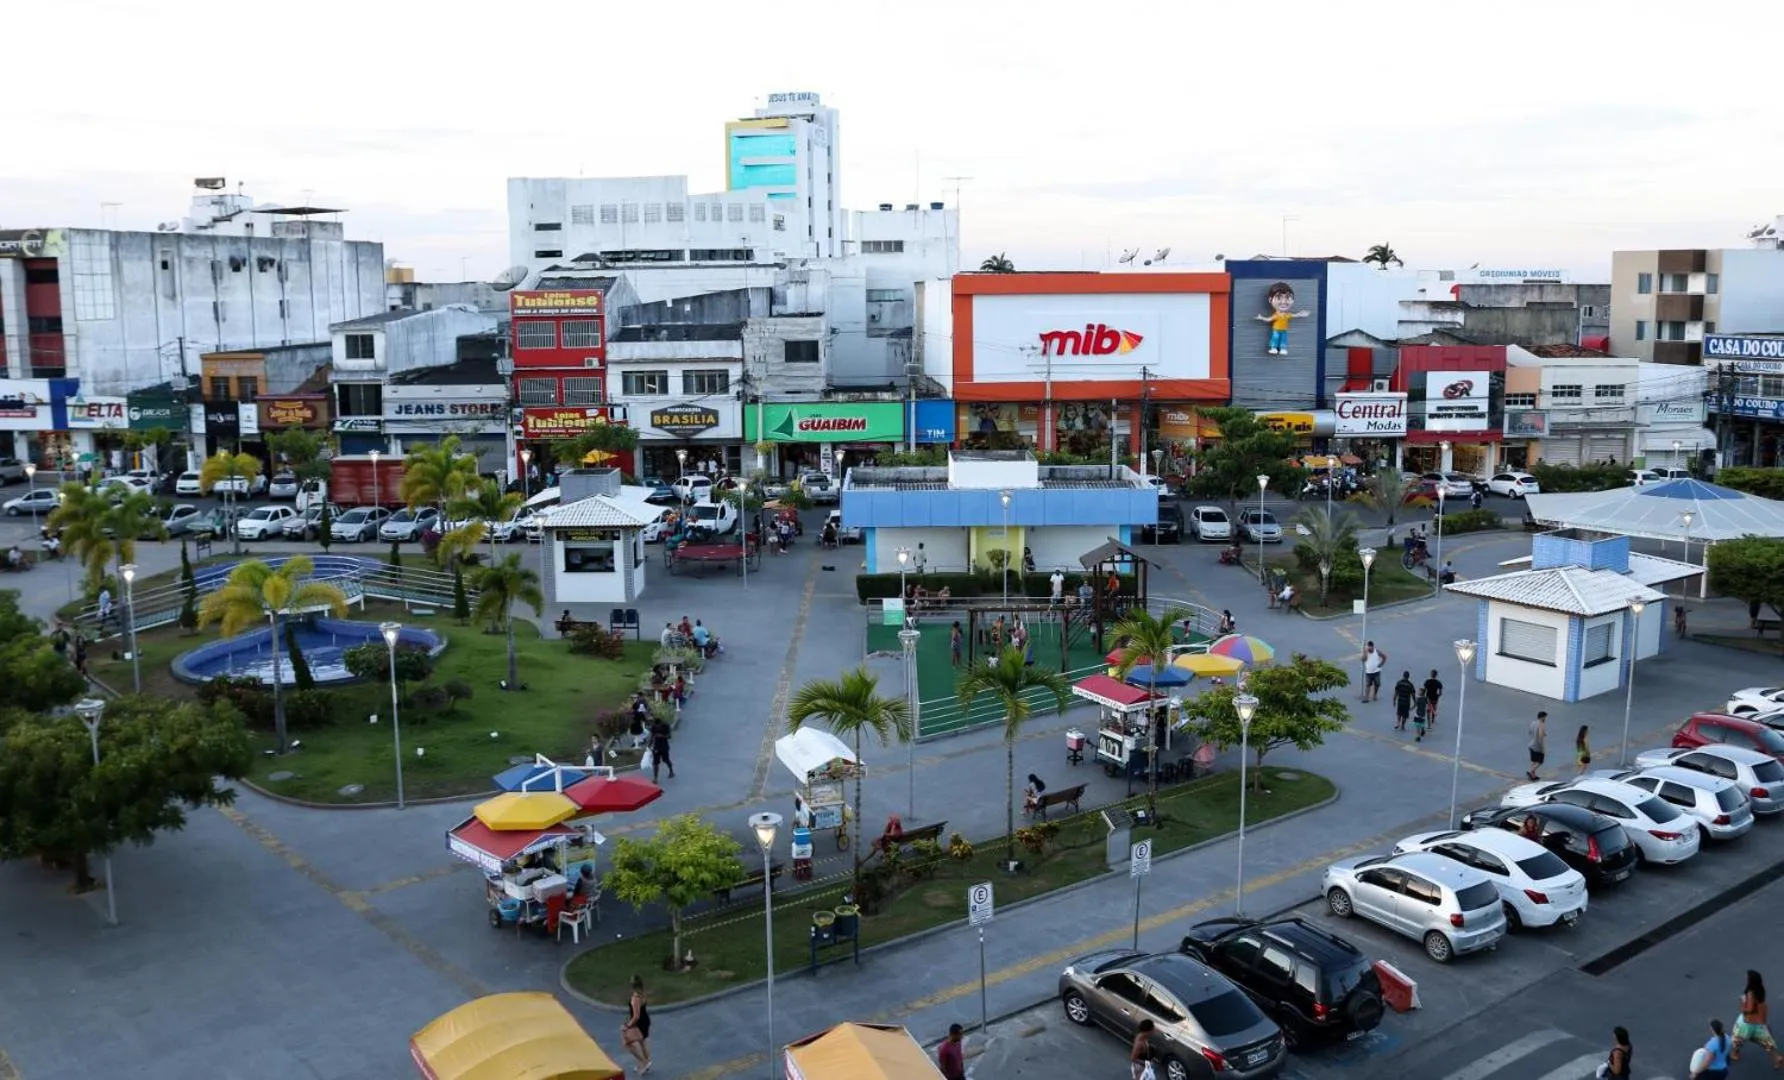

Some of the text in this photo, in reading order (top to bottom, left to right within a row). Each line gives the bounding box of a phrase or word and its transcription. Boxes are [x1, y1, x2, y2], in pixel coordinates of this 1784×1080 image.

[789, 93, 796, 101] TE
[798, 92, 811, 100] AMA
[1039, 324, 1121, 355] mib
[1709, 339, 1740, 354] CASA
[1743, 340, 1760, 355] DO
[395, 404, 445, 415] JEANS
[1338, 400, 1403, 419] Central
[1746, 399, 1777, 409] COURO
[653, 412, 715, 425] BRASÍLIA
[798, 418, 867, 431] GUAIBIM
[1366, 421, 1402, 430] Modas
[927, 429, 945, 438] TIM
[978, 890, 985, 900] E
